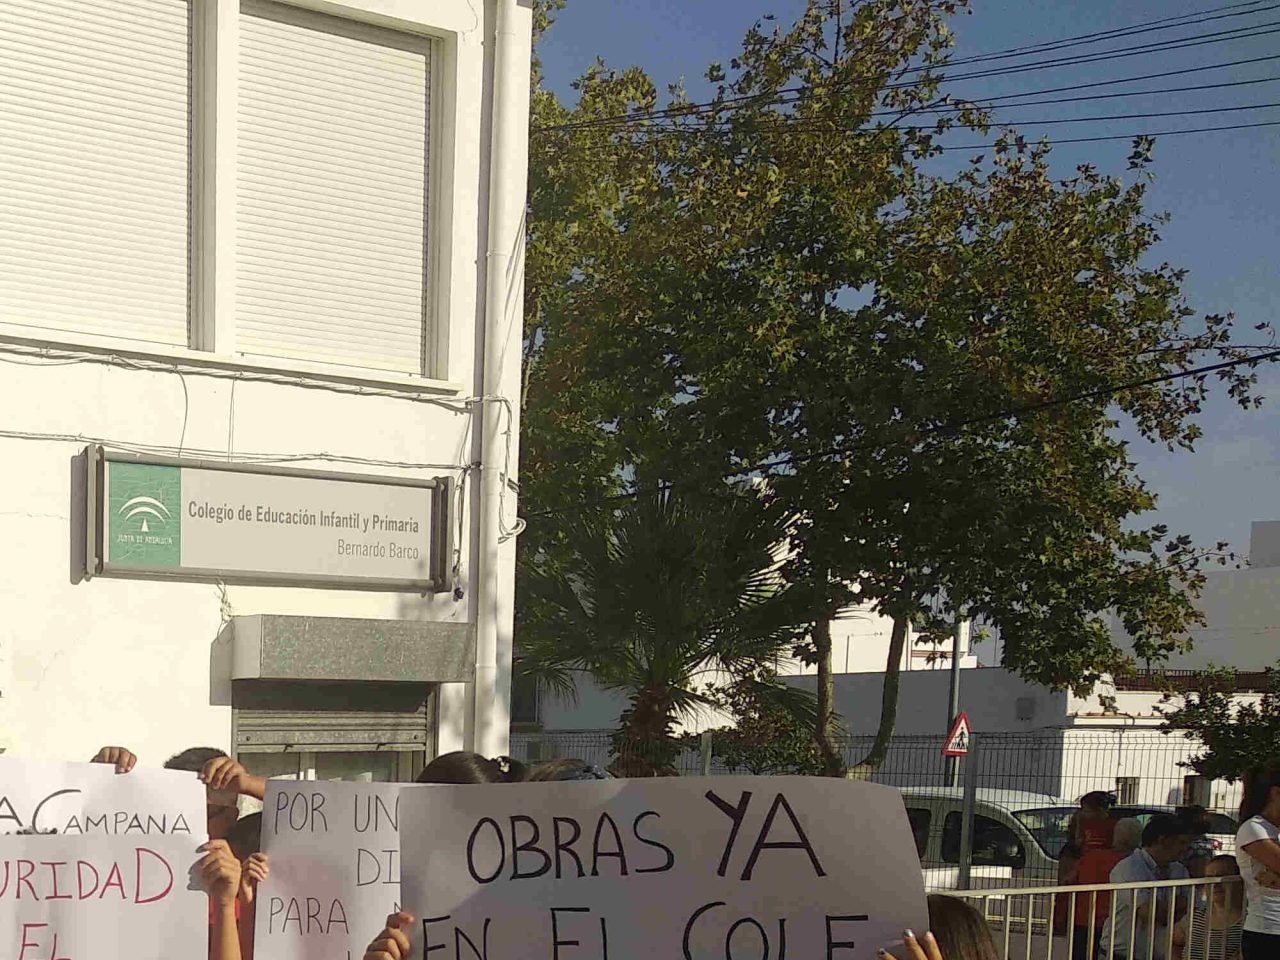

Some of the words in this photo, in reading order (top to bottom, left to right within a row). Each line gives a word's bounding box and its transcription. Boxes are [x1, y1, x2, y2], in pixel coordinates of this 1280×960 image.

[188, 500, 234, 524] Colegio
[237, 504, 253, 522] de
[256, 506, 316, 526] Educación
[319, 510, 360, 529] Infantil
[362, 516, 370, 533] y
[372, 514, 419, 533] Primaria
[337, 538, 386, 558] Bernardo
[389, 542, 419, 560] Barco
[274, 791, 328, 835] POR
[466, 810, 675, 884] OBRAS
[704, 789, 827, 881] YA
[268, 897, 350, 936] PARA
